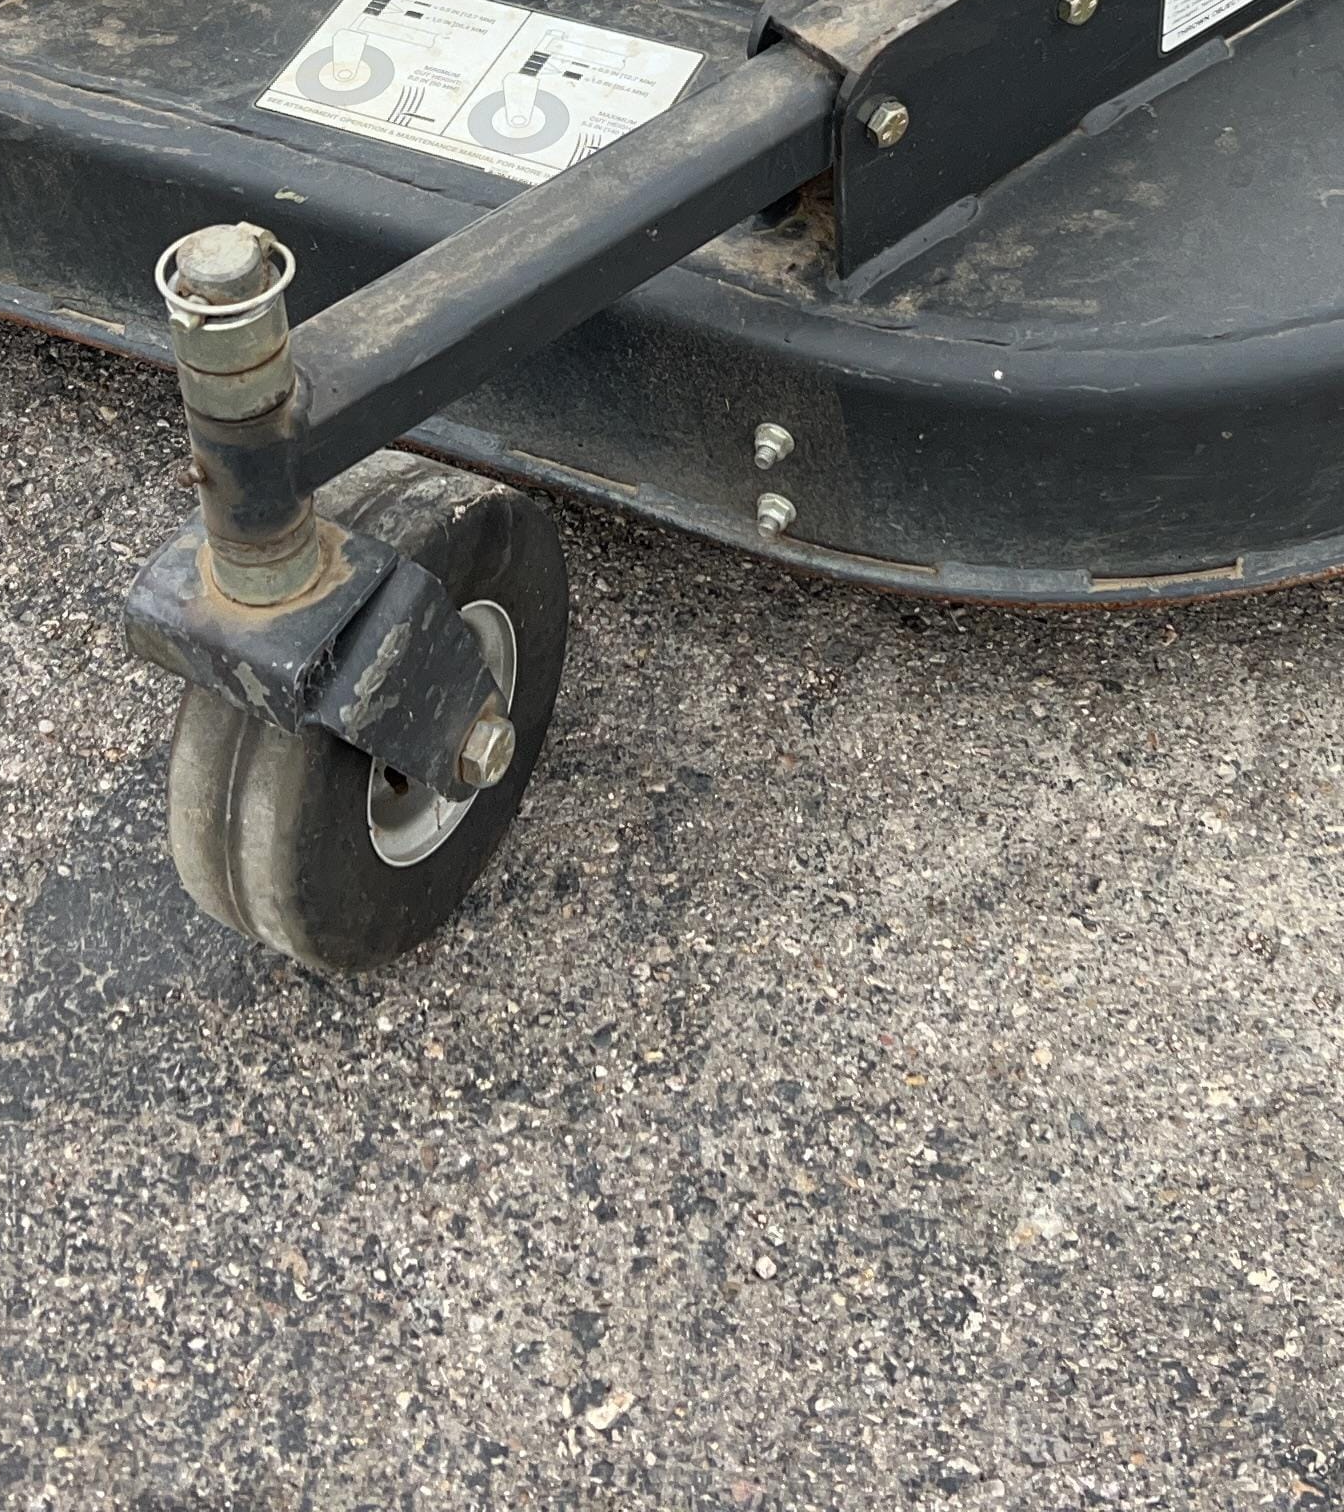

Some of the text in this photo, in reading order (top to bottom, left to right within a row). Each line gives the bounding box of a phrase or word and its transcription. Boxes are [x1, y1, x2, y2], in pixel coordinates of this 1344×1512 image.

[1177, 12, 1209, 38] THROWN
[265, 96, 284, 105] SEE
[281, 100, 340, 120] ATTACHMENT
[336, 115, 389, 133] OPERATION
[393, 131, 460, 152] MAINTENANCE
[456, 148, 497, 163] MANUAL
[495, 158, 517, 168] FOR
[514, 165, 542, 176] MORE
